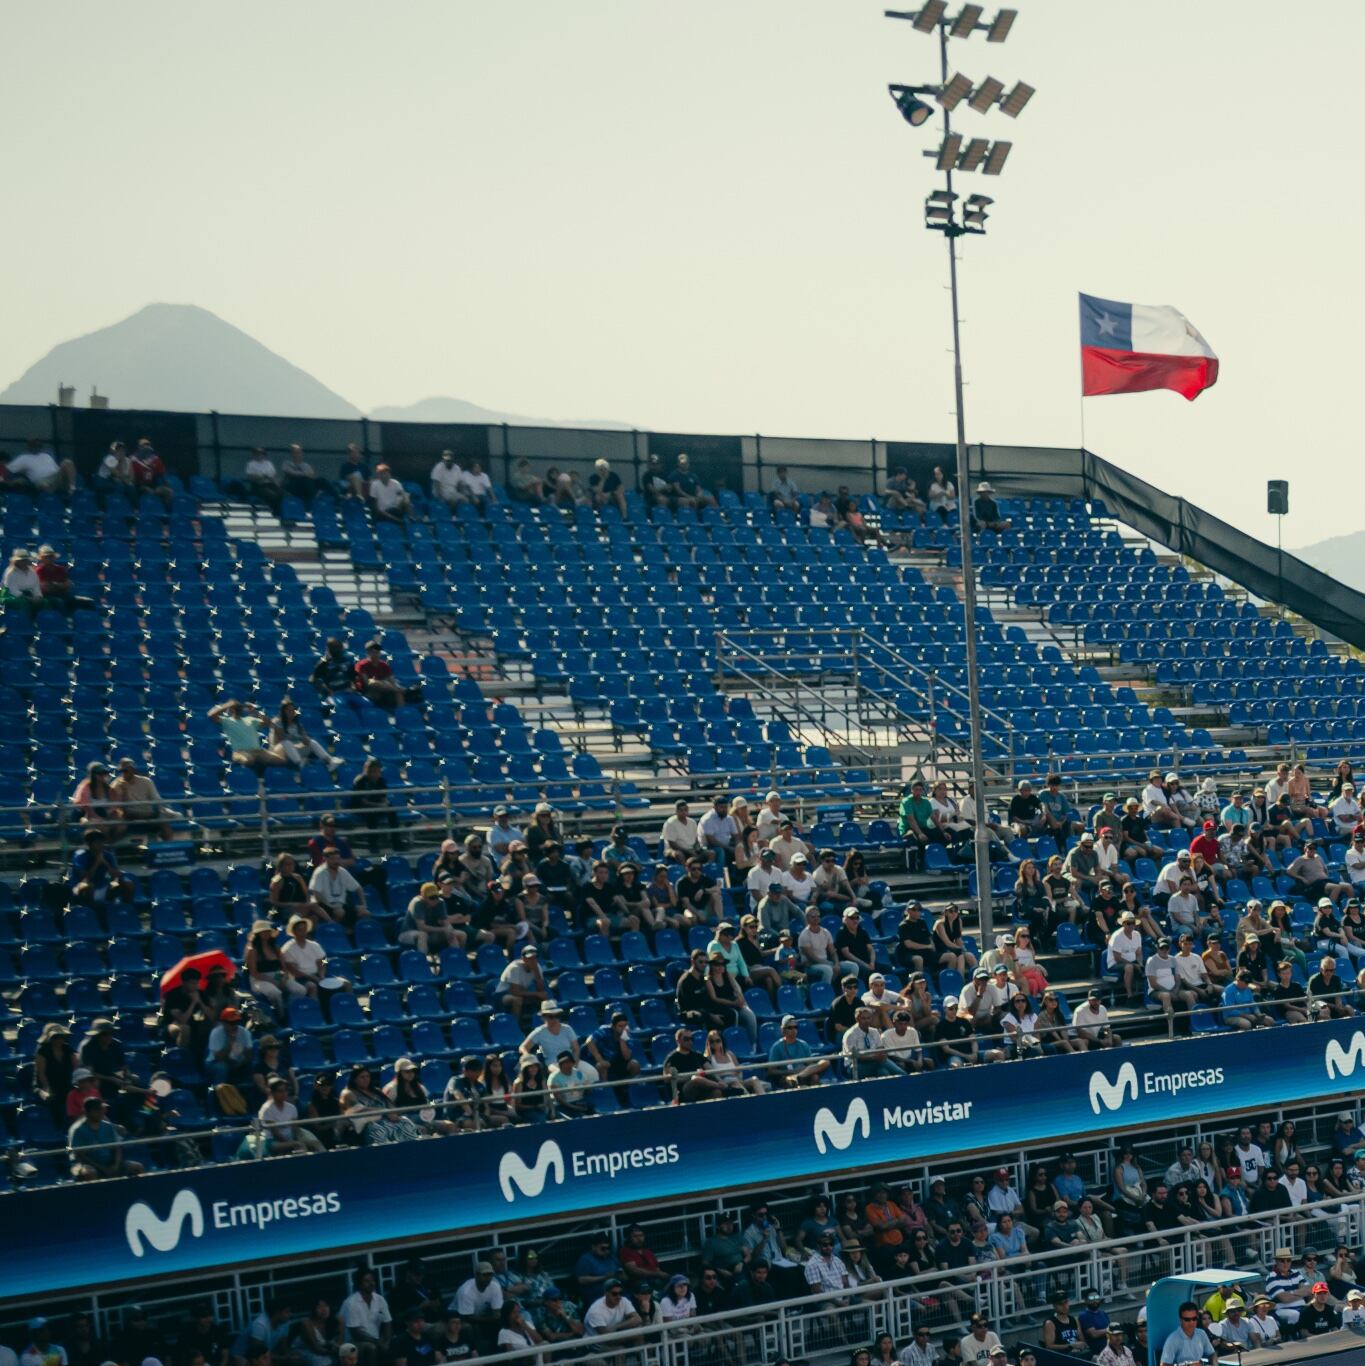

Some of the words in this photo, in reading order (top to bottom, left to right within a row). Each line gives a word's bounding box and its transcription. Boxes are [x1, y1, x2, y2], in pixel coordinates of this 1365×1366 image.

[1143, 1067, 1225, 1096] Empresas
[883, 1100, 973, 1130] Movistar
[572, 1143, 680, 1178] Empresas
[212, 1191, 341, 1230] Empresas
